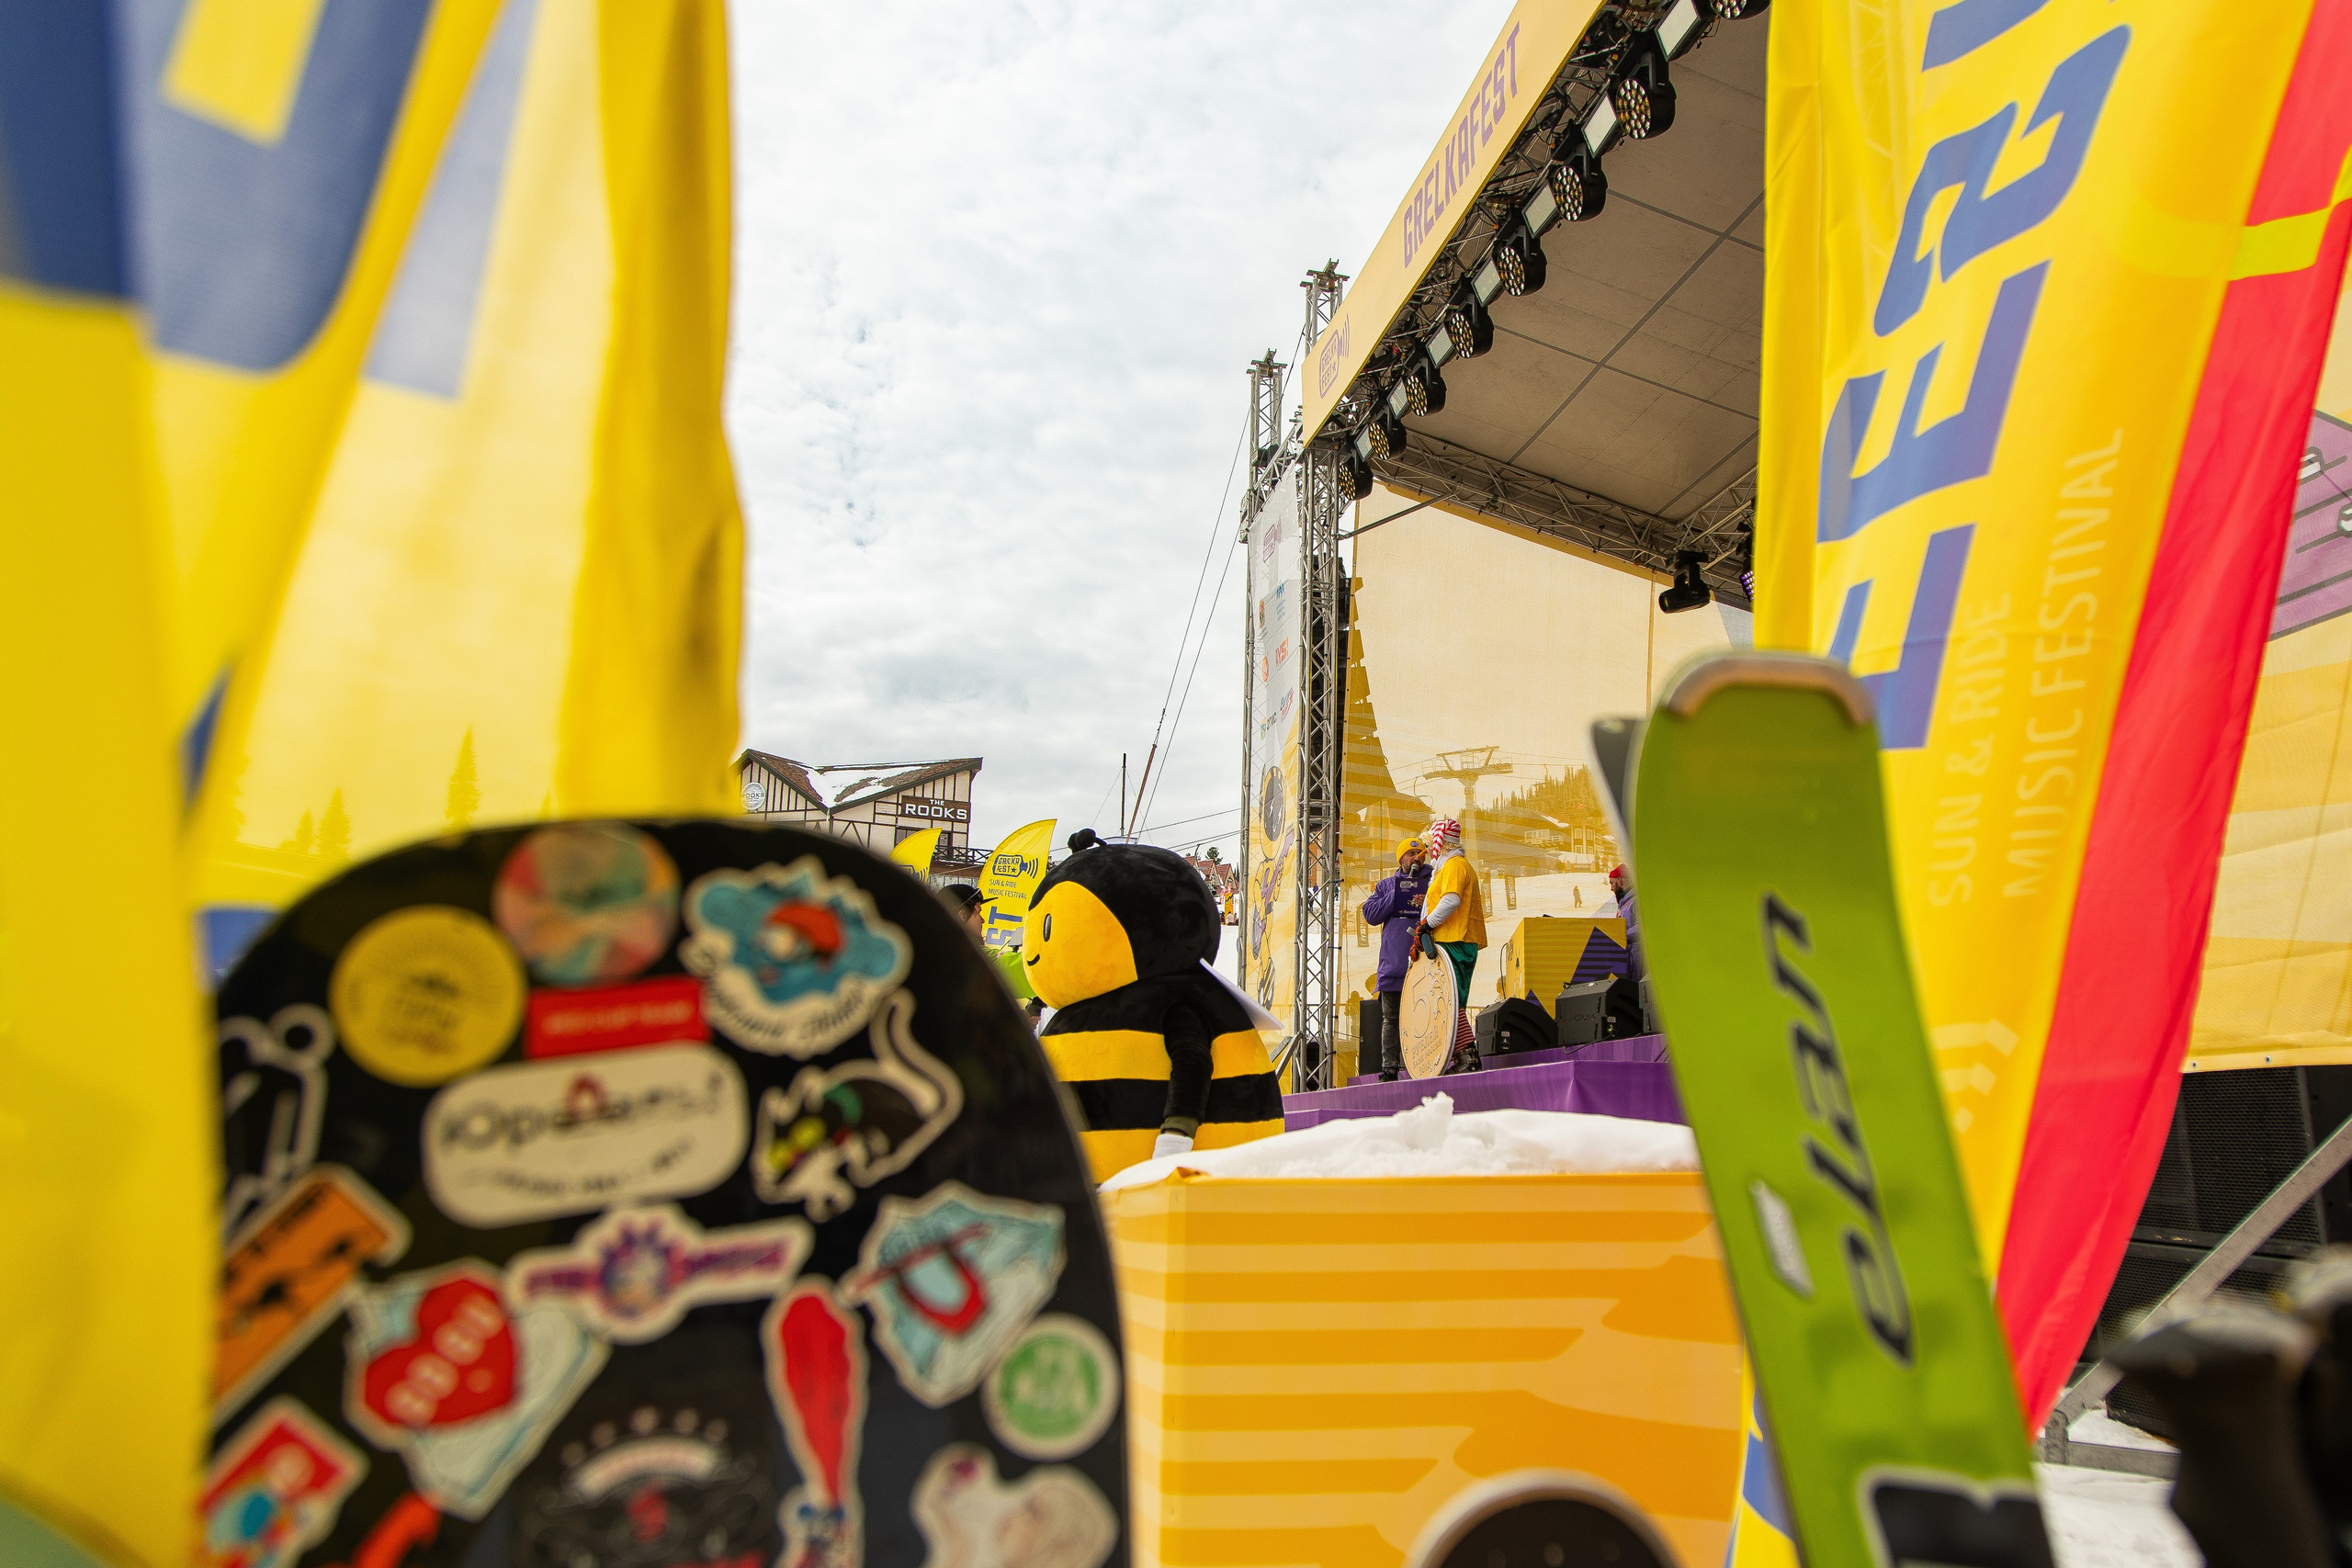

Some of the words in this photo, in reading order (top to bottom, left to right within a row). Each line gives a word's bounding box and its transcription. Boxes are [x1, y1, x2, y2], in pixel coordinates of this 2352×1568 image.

[1403, 20, 1521, 269] GRELKAFEST
[2031, 427, 2124, 698] FESTIVAL
[1950, 592, 2012, 725] RIDE
[1945, 734, 1996, 775] &
[905, 803, 967, 820] ROOKS
[2002, 708, 2084, 897] MUSIC
[988, 888, 1004, 897] MUSIC
[1004, 889, 1027, 899] FESTIVAL
[1005, 880, 1017, 888] RIDE
[1928, 792, 1984, 908] SUN
[986, 906, 1023, 945] ST
[1410, 966, 1431, 1039] 5
[1763, 890, 1915, 1368] elan
